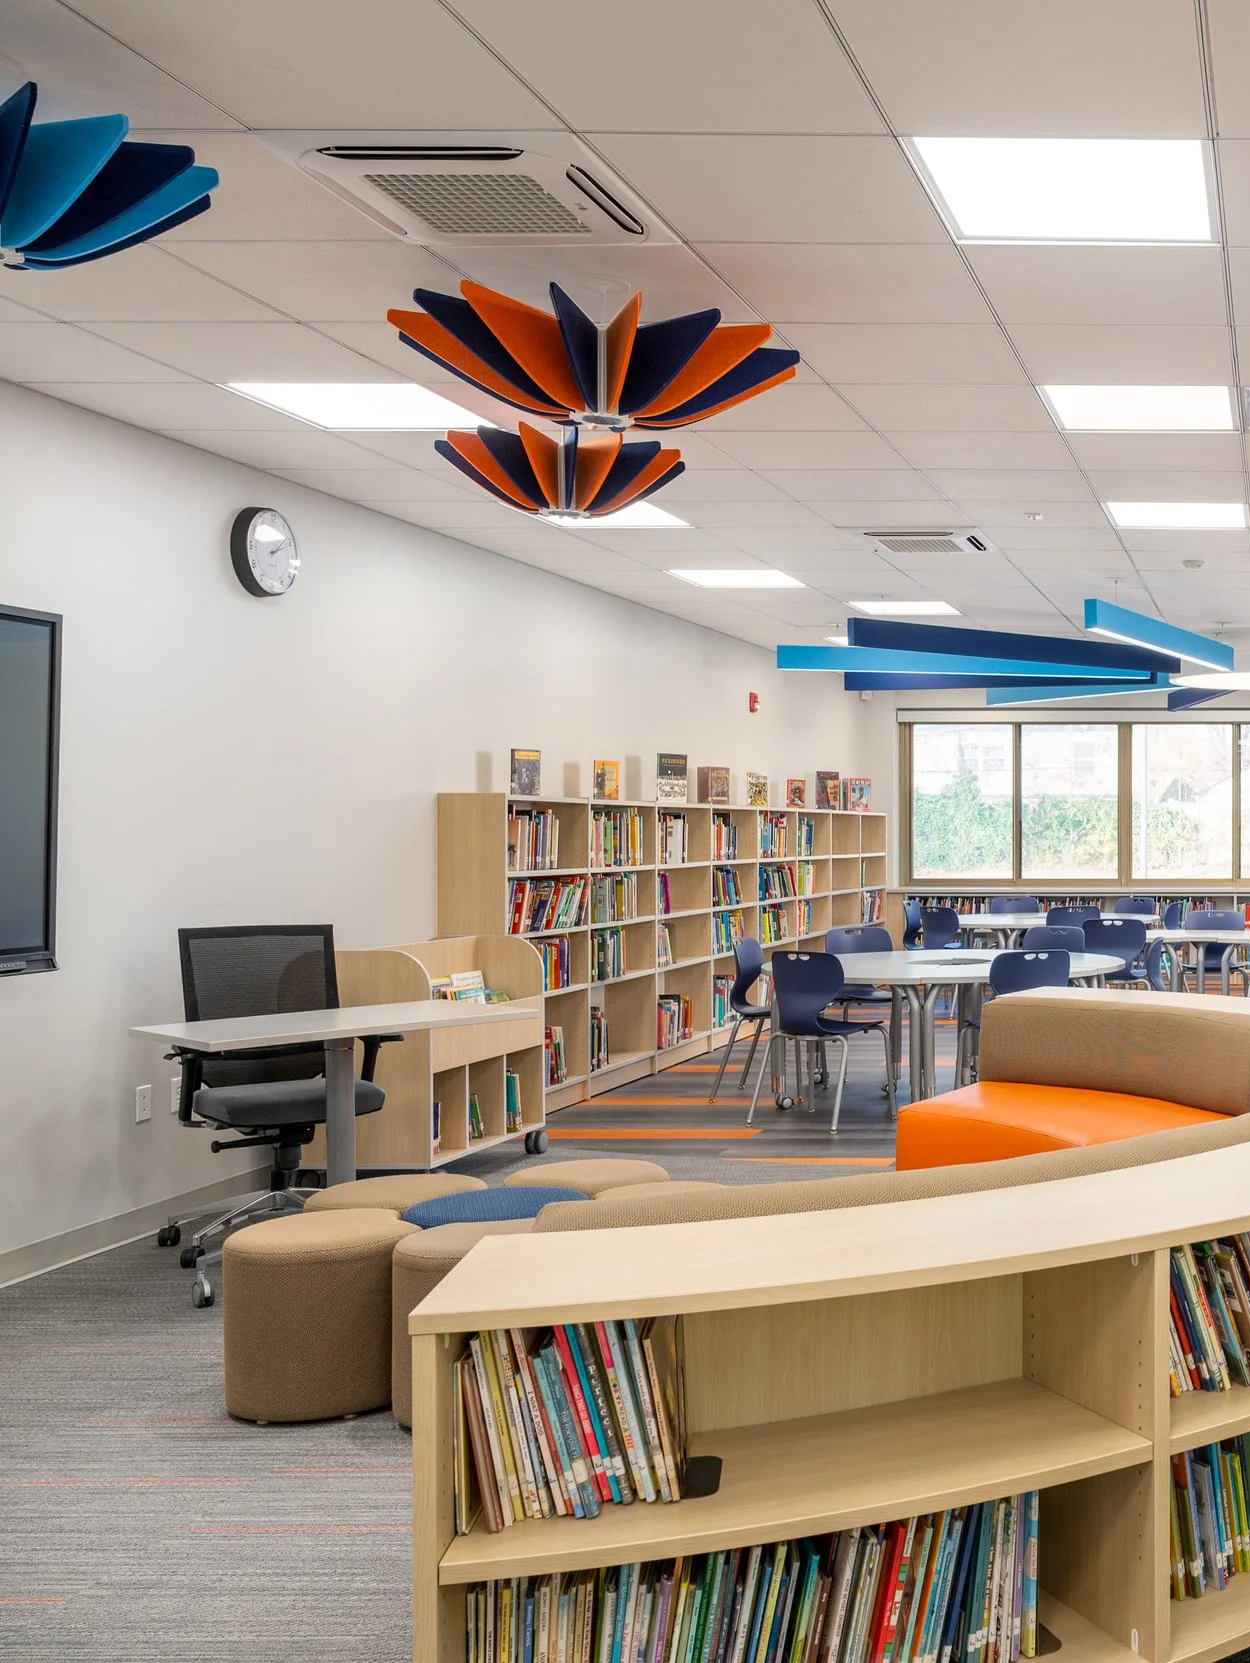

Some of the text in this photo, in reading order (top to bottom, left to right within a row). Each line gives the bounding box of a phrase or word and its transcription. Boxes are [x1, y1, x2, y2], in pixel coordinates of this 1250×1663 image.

[587, 1364, 613, 1436] Perfect
[528, 1396, 537, 1413] WANT
[534, 1420, 543, 1435] DOG
[560, 1411, 568, 1422] THE
[617, 1406, 626, 1425] READ
